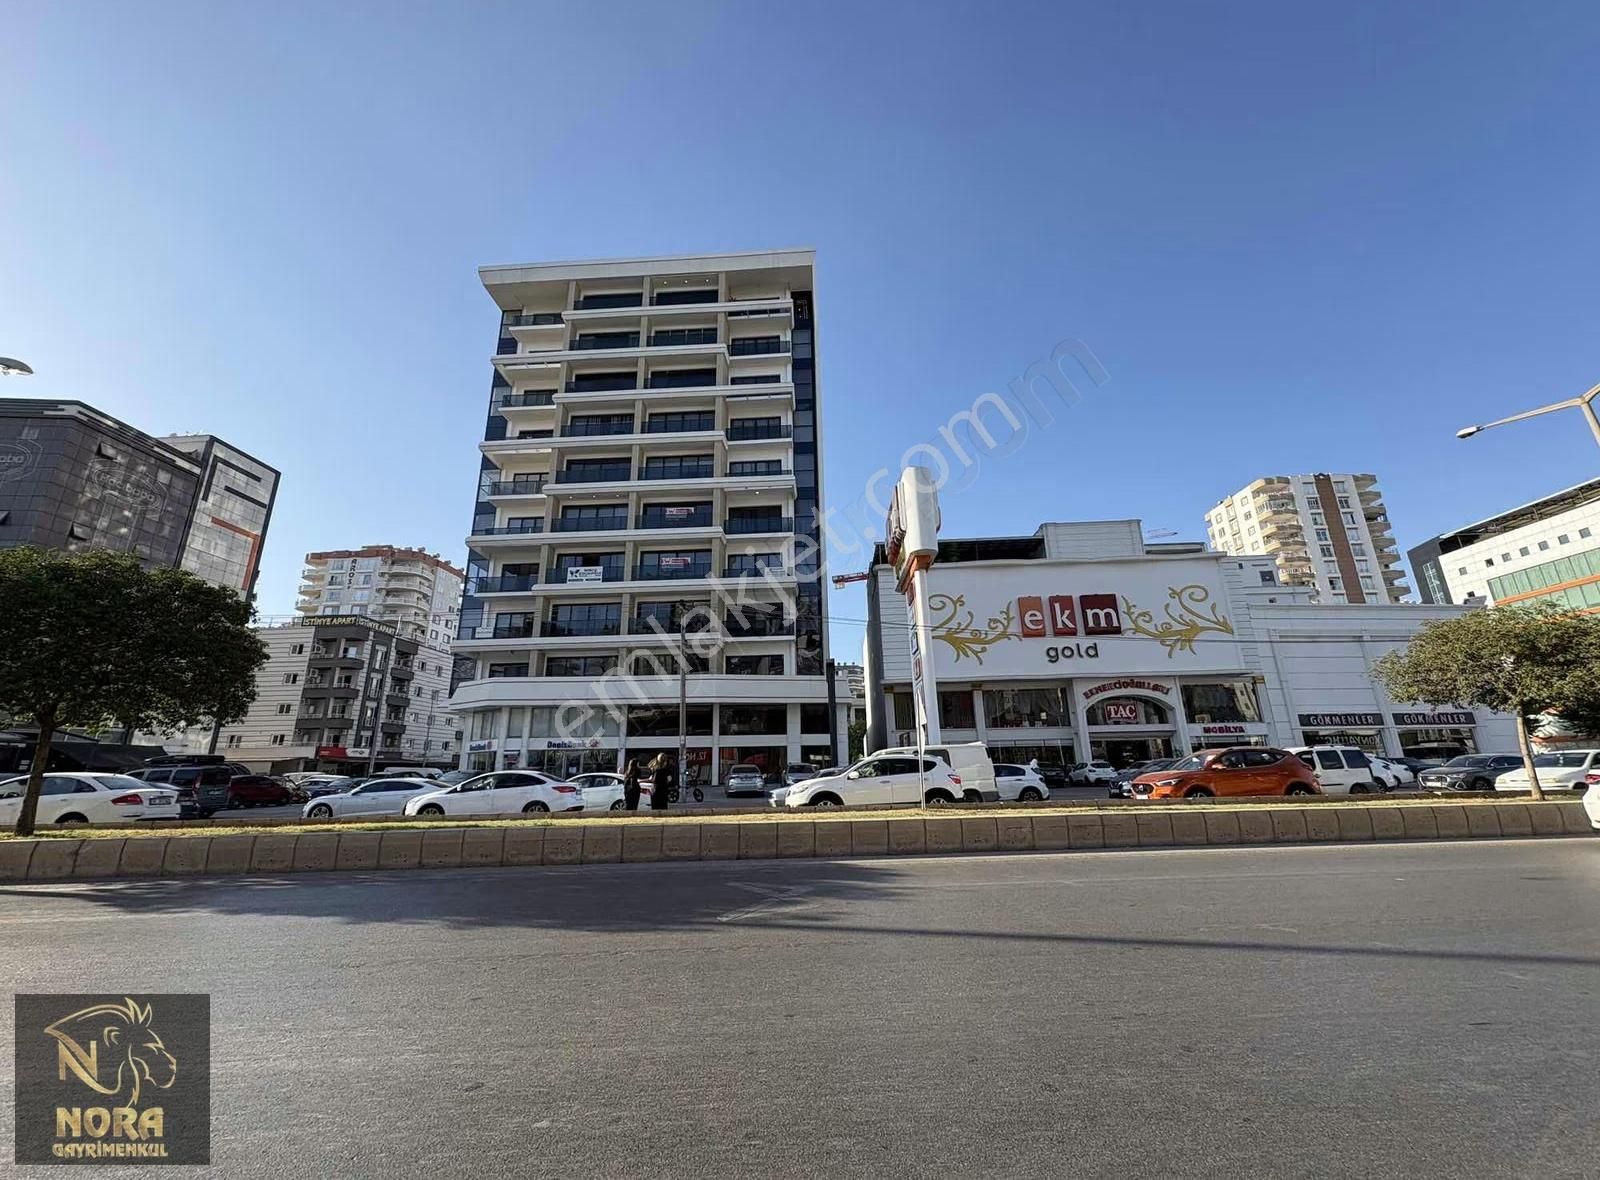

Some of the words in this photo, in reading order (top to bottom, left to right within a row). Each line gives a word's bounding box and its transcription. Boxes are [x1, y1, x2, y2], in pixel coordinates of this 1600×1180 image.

[332, 616, 356, 625] APART
[1024, 602, 1120, 630] ekm
[379, 624, 396, 635] APART
[1046, 642, 1099, 663] gold
[1107, 704, 1136, 719] TAÇ
[1310, 715, 1375, 725] GÖKMENLER
[1203, 724, 1246, 734] MOBİLYA
